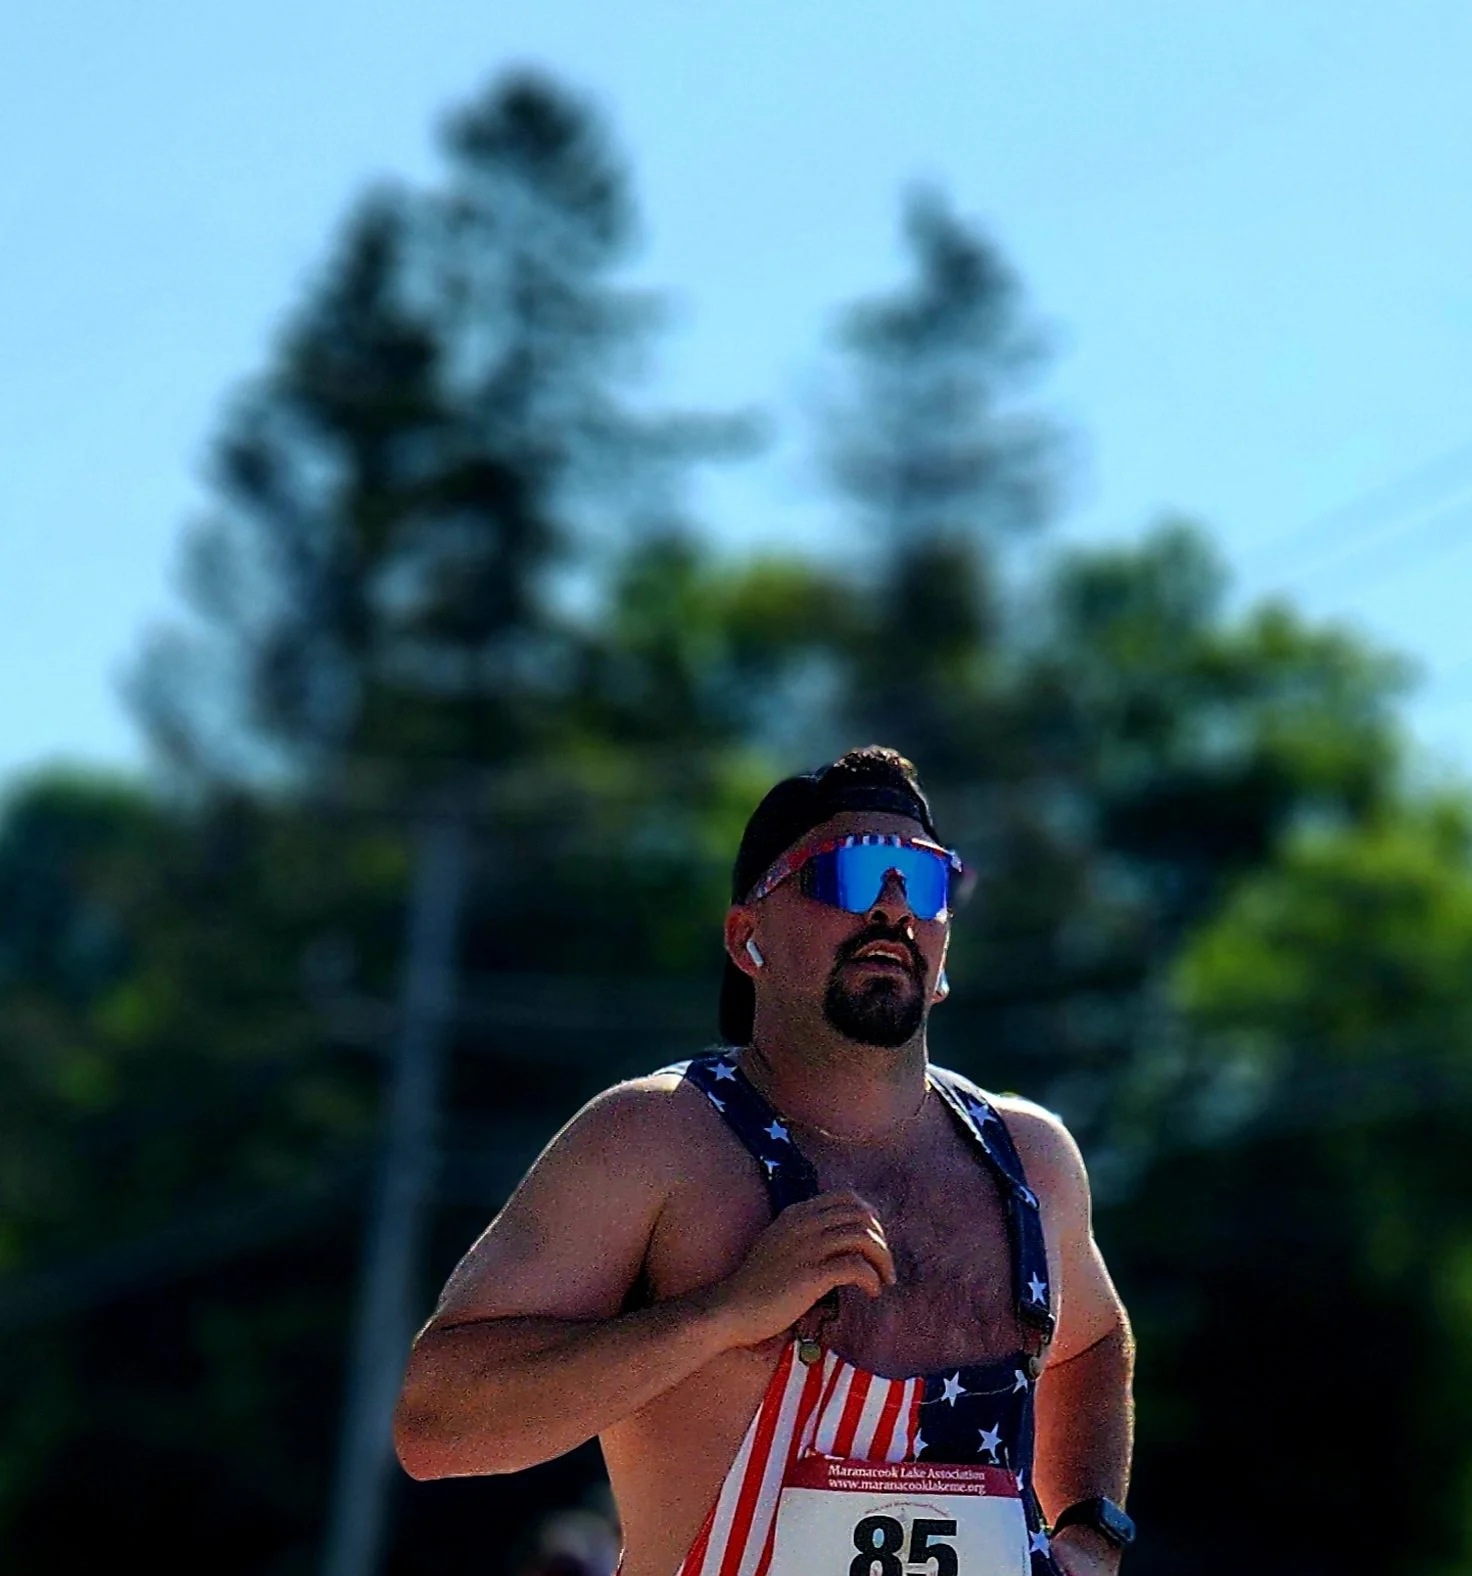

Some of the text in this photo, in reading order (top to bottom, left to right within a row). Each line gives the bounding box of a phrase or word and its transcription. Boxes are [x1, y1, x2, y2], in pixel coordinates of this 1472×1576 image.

[828, 1465, 985, 1481] Maranacook Lake Association
[828, 1479, 986, 1495] www.maranacooklakeme.org
